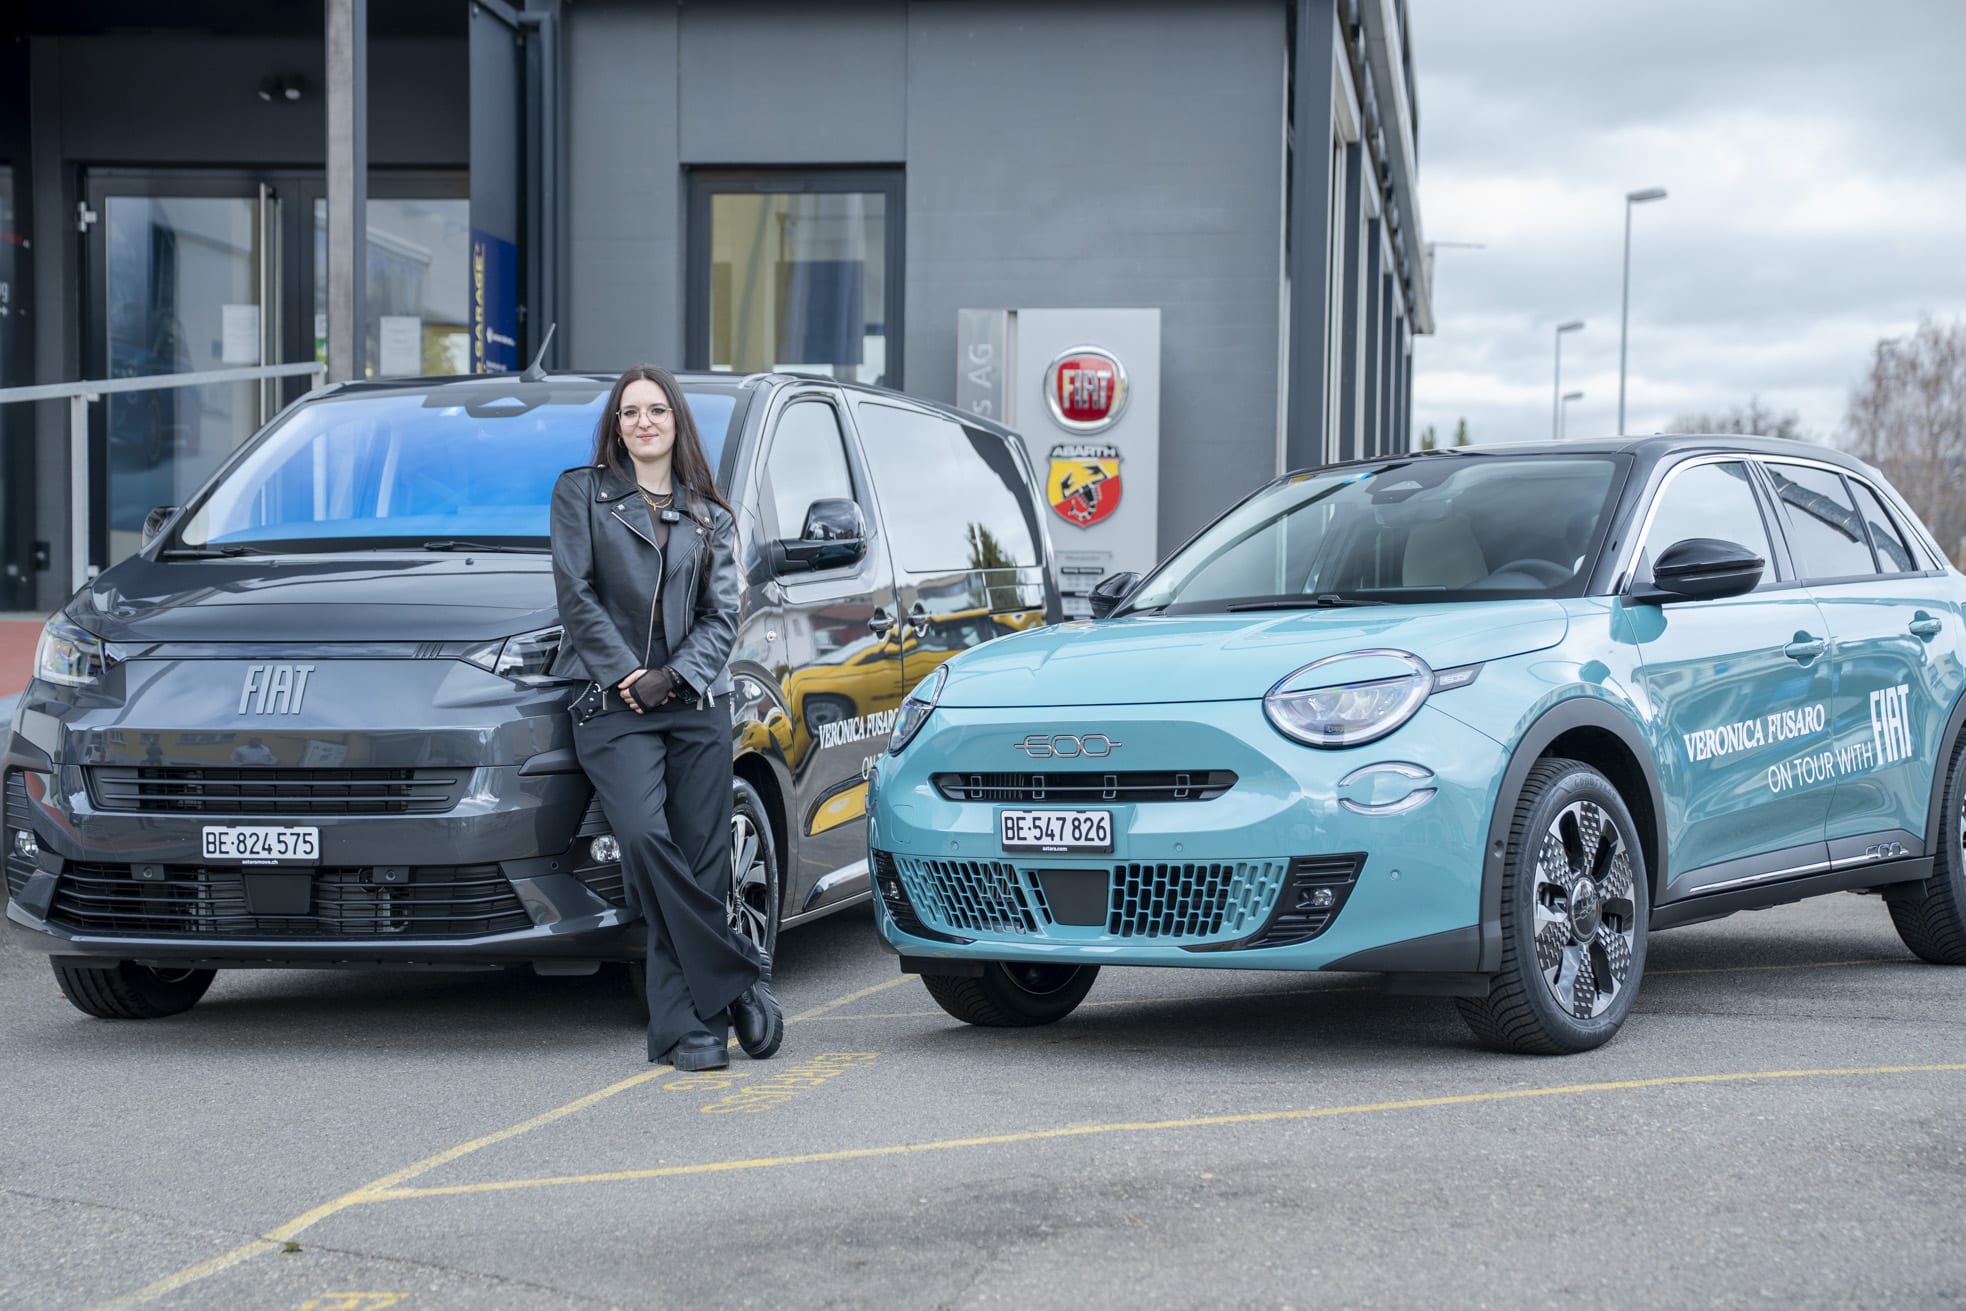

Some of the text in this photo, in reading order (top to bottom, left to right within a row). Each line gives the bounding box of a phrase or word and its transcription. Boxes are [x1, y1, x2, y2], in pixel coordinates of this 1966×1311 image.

[1062, 370, 1111, 410] FIAT
[1052, 445, 1117, 457] ABARTH
[238, 665, 315, 716] FIAT
[818, 715, 865, 750] VERONICA
[1013, 734, 1122, 759] 600
[1683, 703, 1826, 762] VERONICA FUSARO
[1767, 684, 1913, 793] ON TOUR WITH FIAT
[277, 832, 314, 855] 575
[1071, 816, 1108, 842] 826
